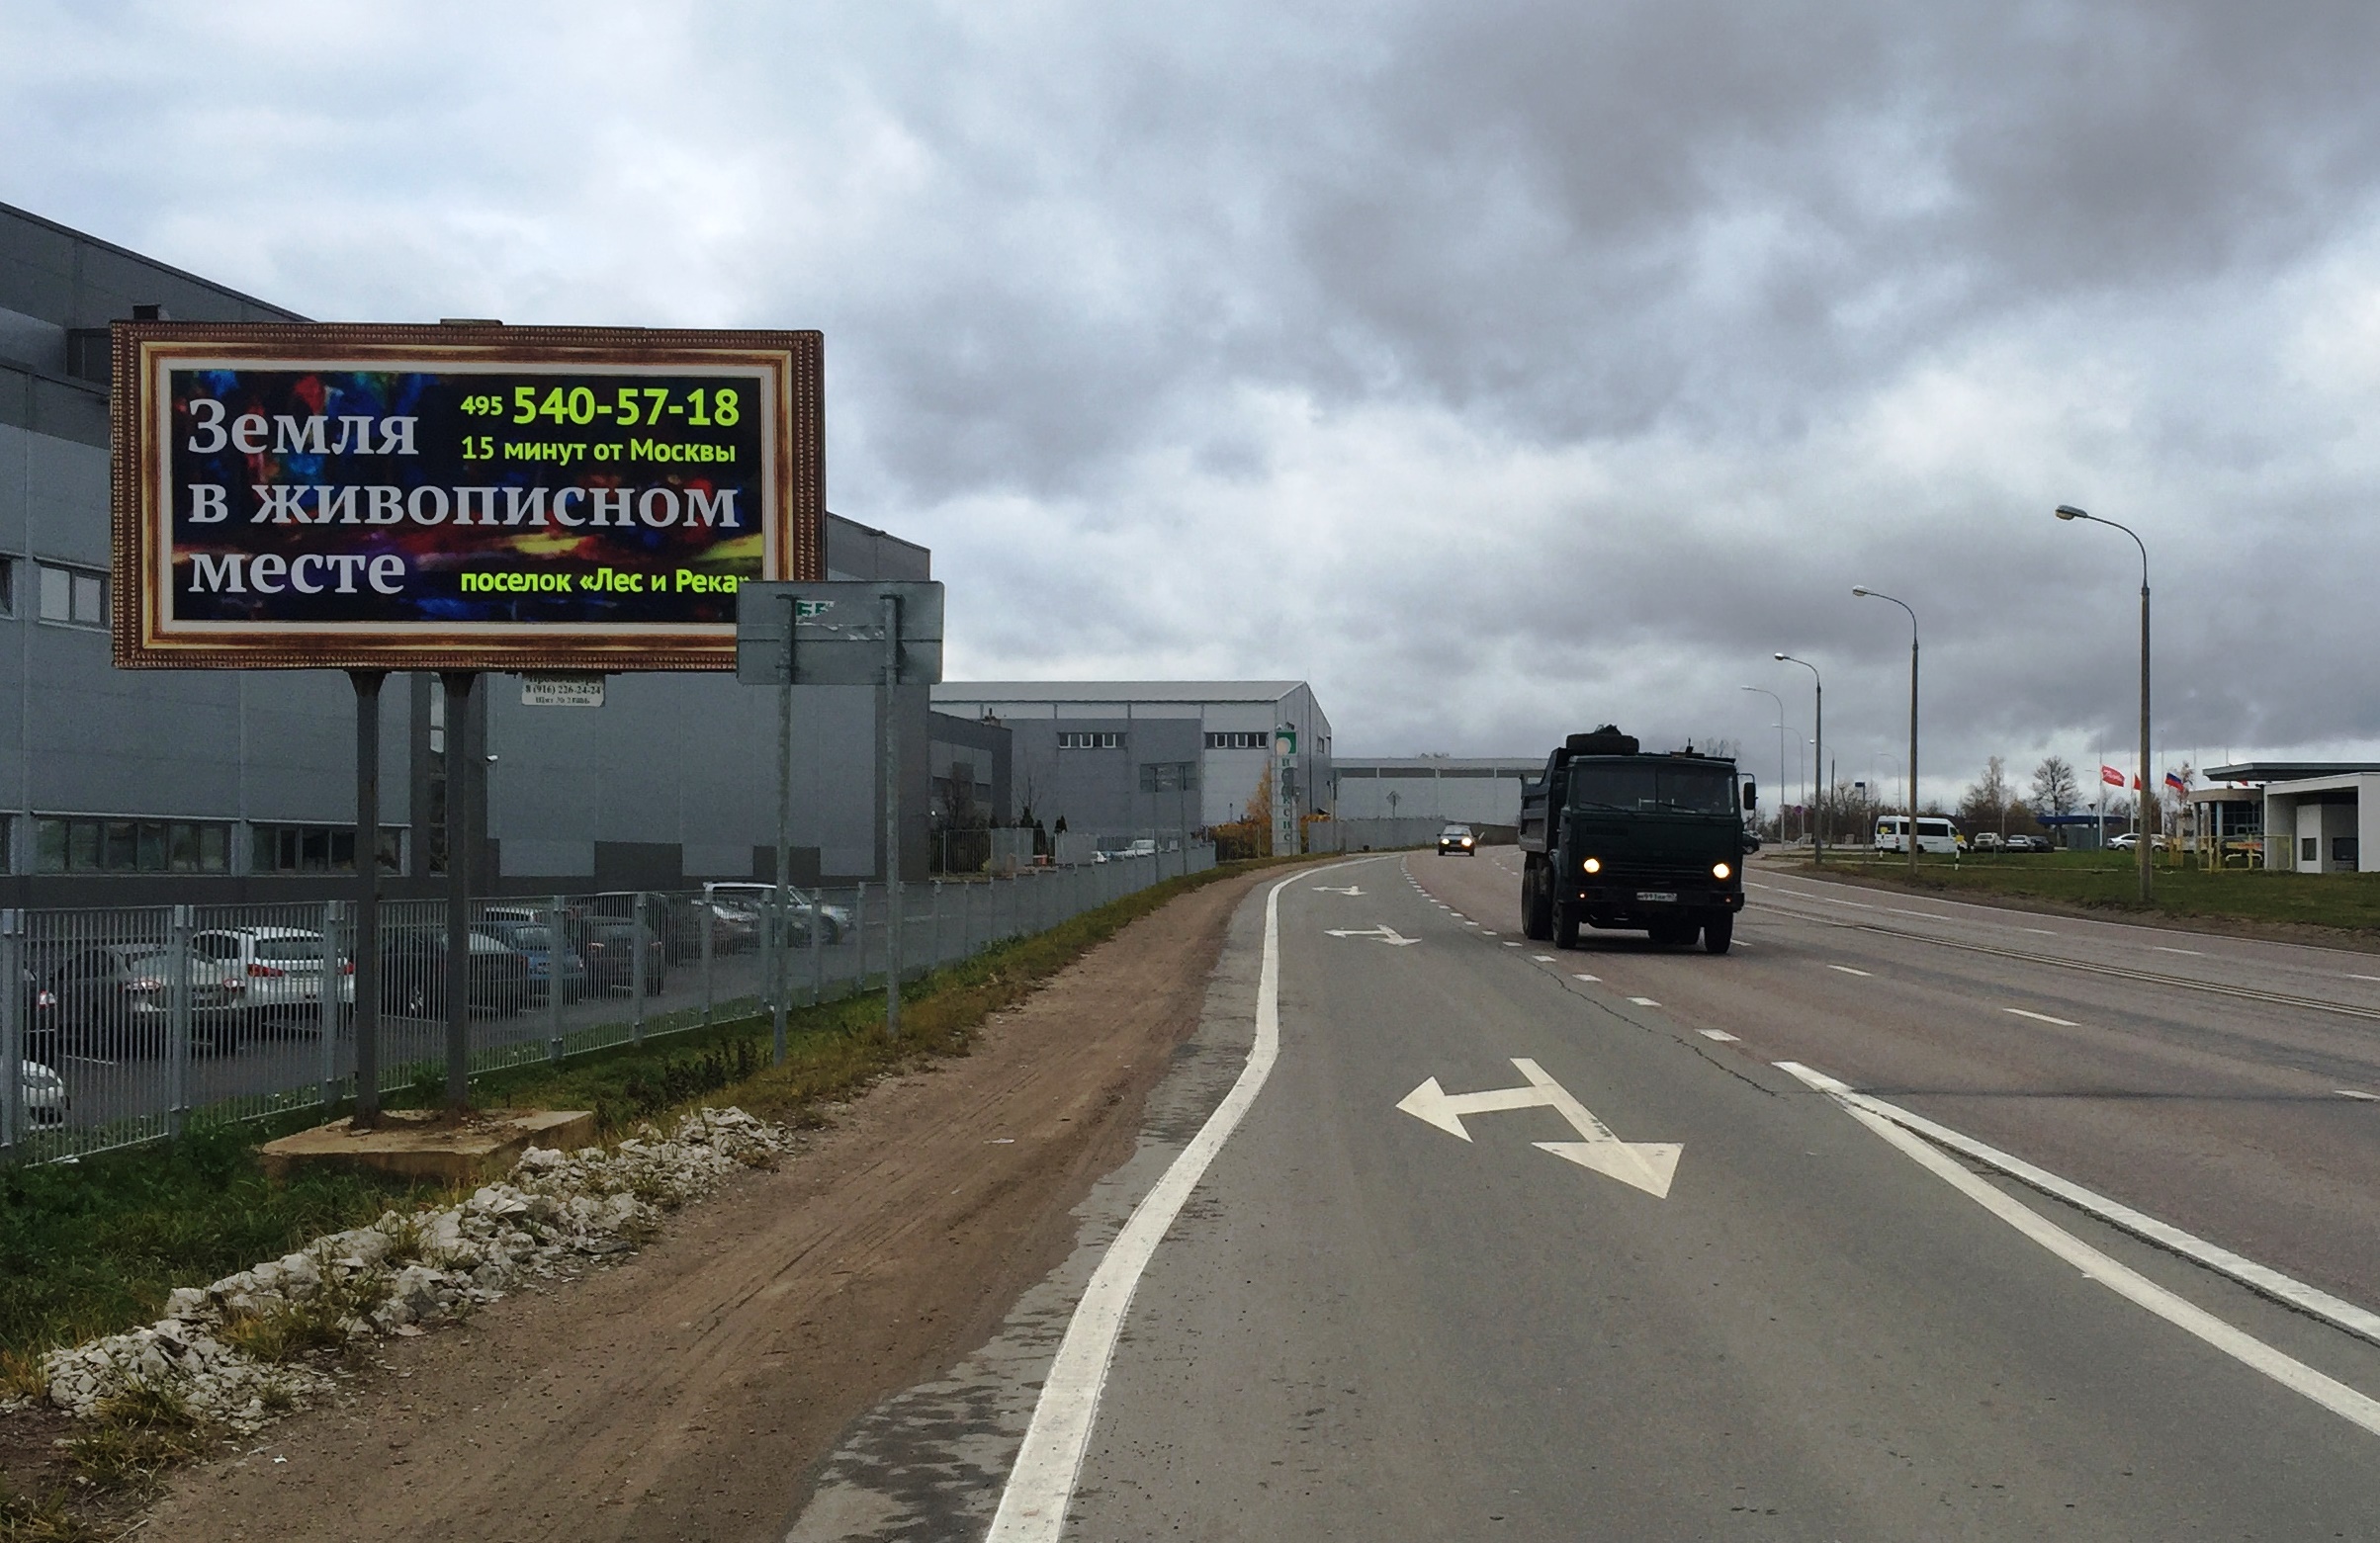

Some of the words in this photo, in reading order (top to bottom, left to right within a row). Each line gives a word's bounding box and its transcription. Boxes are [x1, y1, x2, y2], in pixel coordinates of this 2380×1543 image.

[188, 398, 419, 455] Земля
[460, 395, 502, 416] 495
[513, 386, 740, 427] 540-57-18
[462, 436, 493, 460] 15
[504, 442, 586, 466] минут
[593, 443, 623, 462] от
[630, 438, 736, 463] Москвы
[188, 483, 228, 524] в
[250, 484, 740, 528] живописном
[188, 553, 405, 594] месте
[461, 572, 572, 593] поселок
[579, 567, 643, 593] «Лес
[651, 574, 666, 591] и
